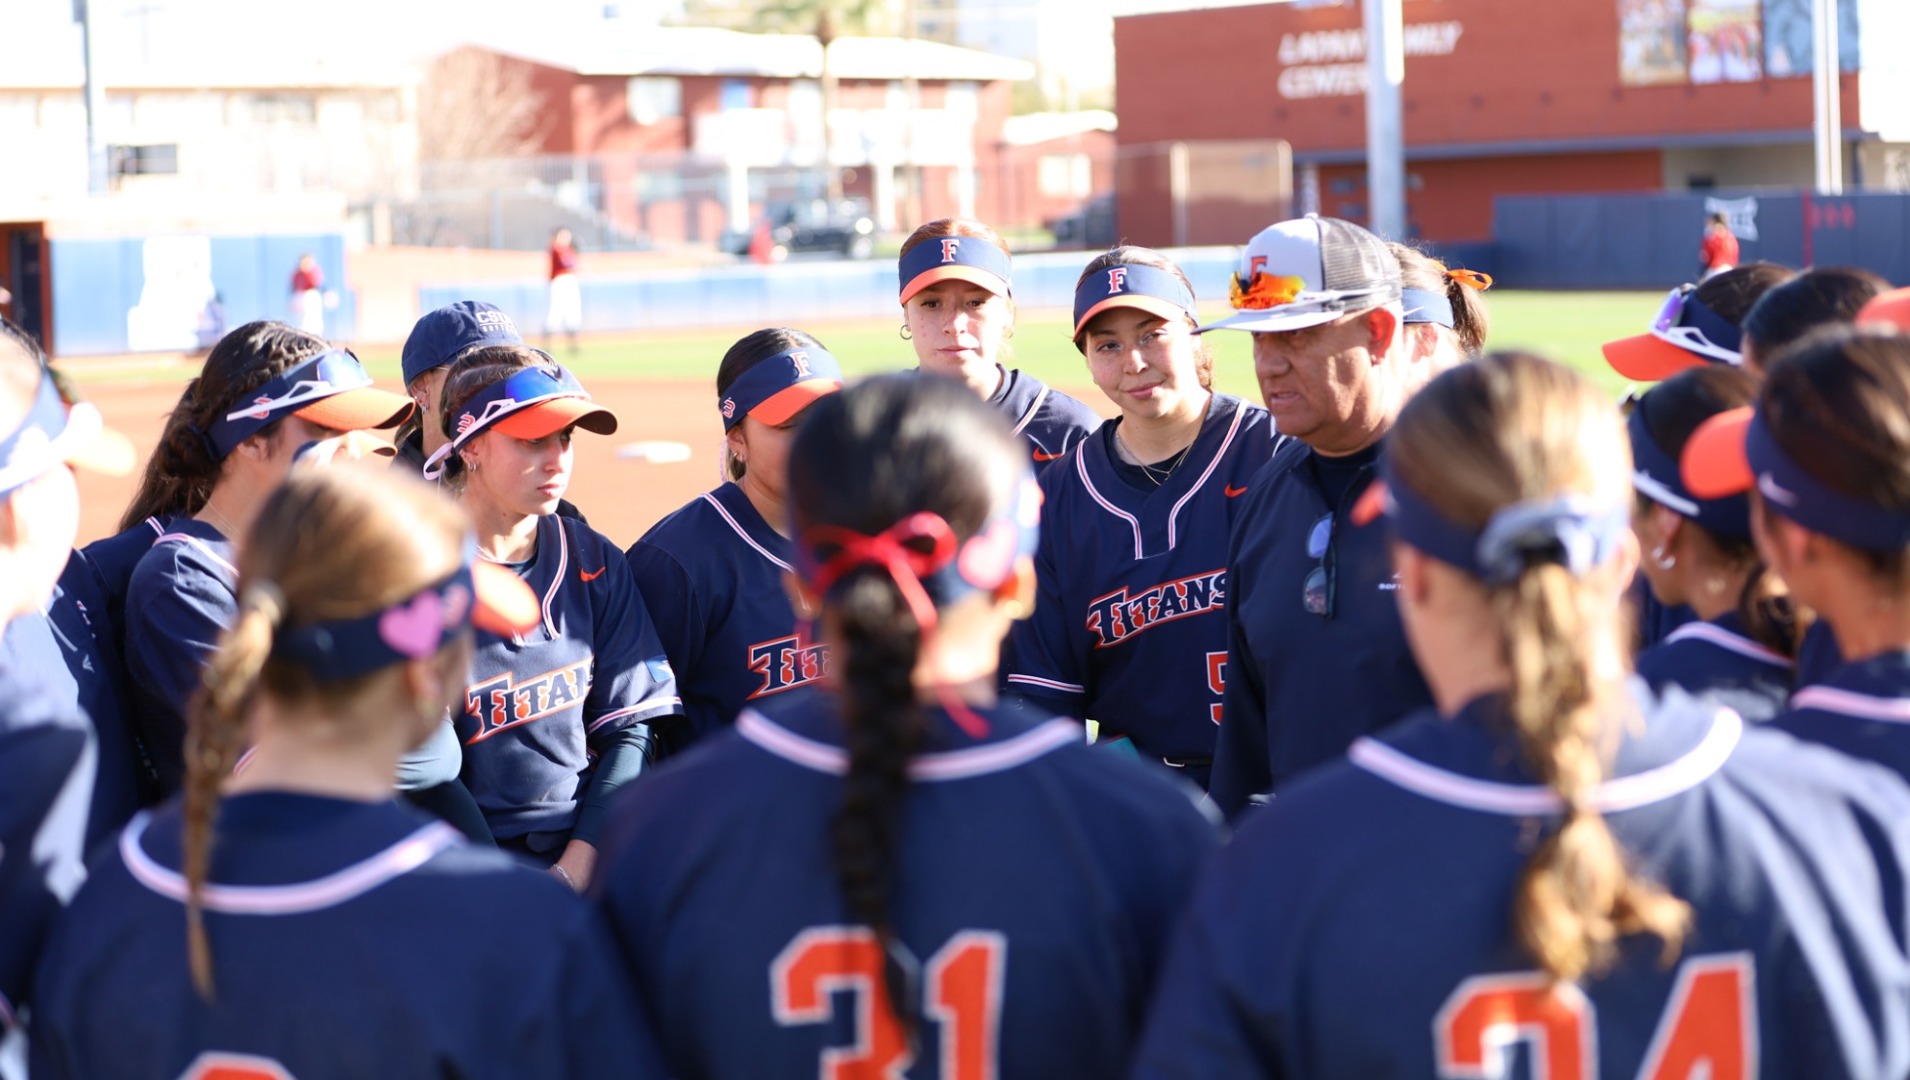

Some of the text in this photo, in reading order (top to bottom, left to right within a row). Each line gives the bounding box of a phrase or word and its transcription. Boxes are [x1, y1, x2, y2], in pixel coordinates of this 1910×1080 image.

[1403, 22, 1462, 55] MILY
[941, 239, 960, 263] F
[1108, 267, 1127, 294] F
[789, 351, 812, 378] F
[1085, 567, 1228, 650] TITANS
[746, 633, 833, 700] TIT
[465, 654, 595, 745] TITAN
